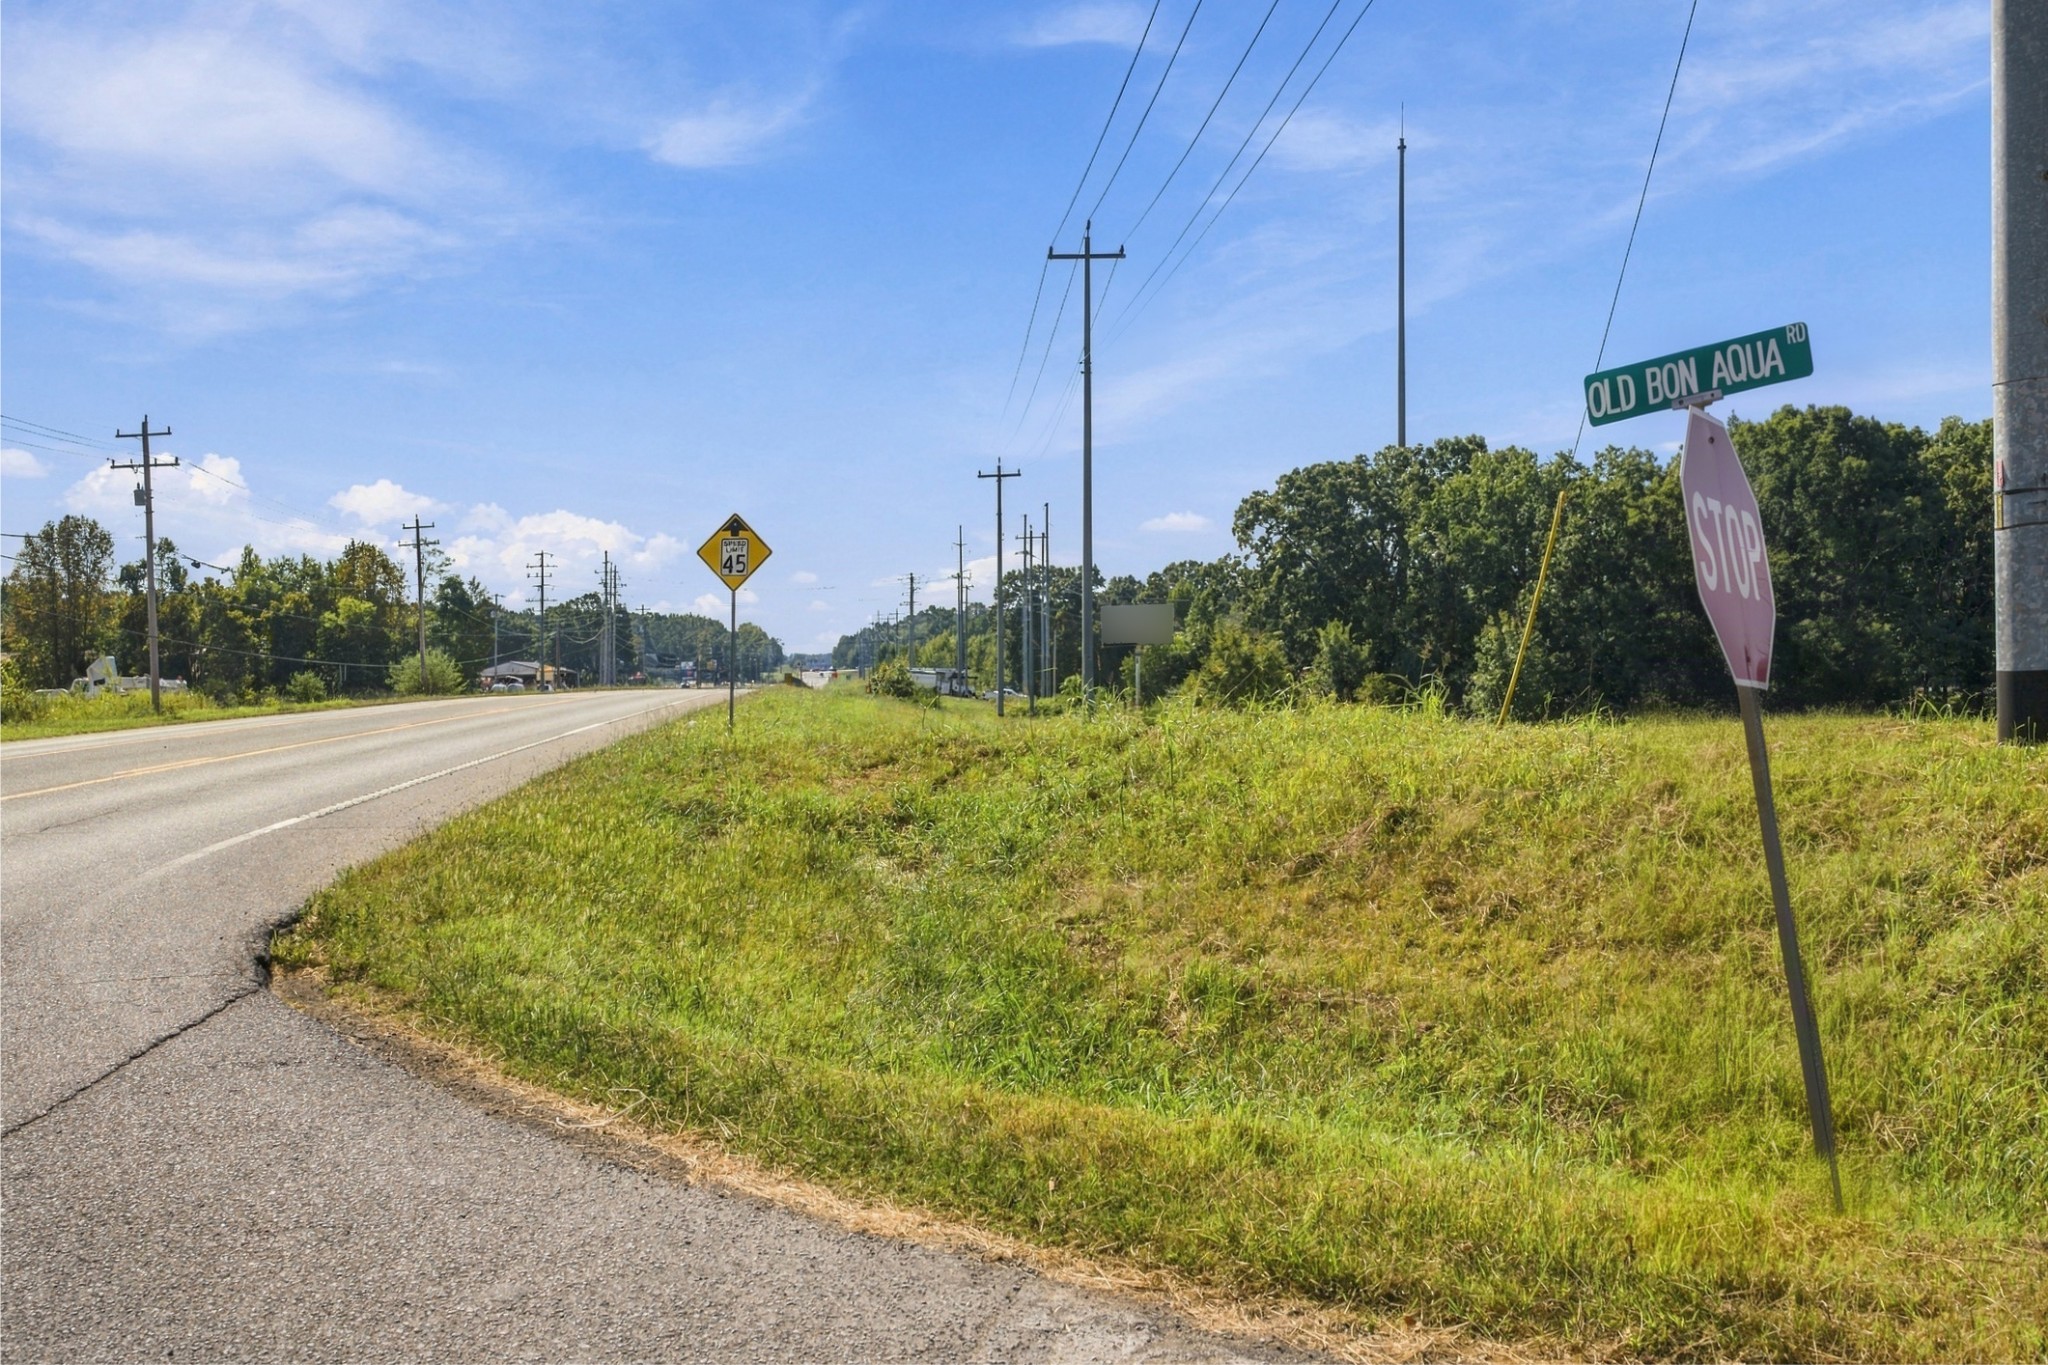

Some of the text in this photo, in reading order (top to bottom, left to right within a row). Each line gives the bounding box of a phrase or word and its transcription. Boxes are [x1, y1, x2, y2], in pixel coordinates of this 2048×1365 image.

[1588, 323, 1806, 419] OLD BON AQUA RD
[722, 554, 746, 574] 45
[1692, 491, 1762, 601] STOP
